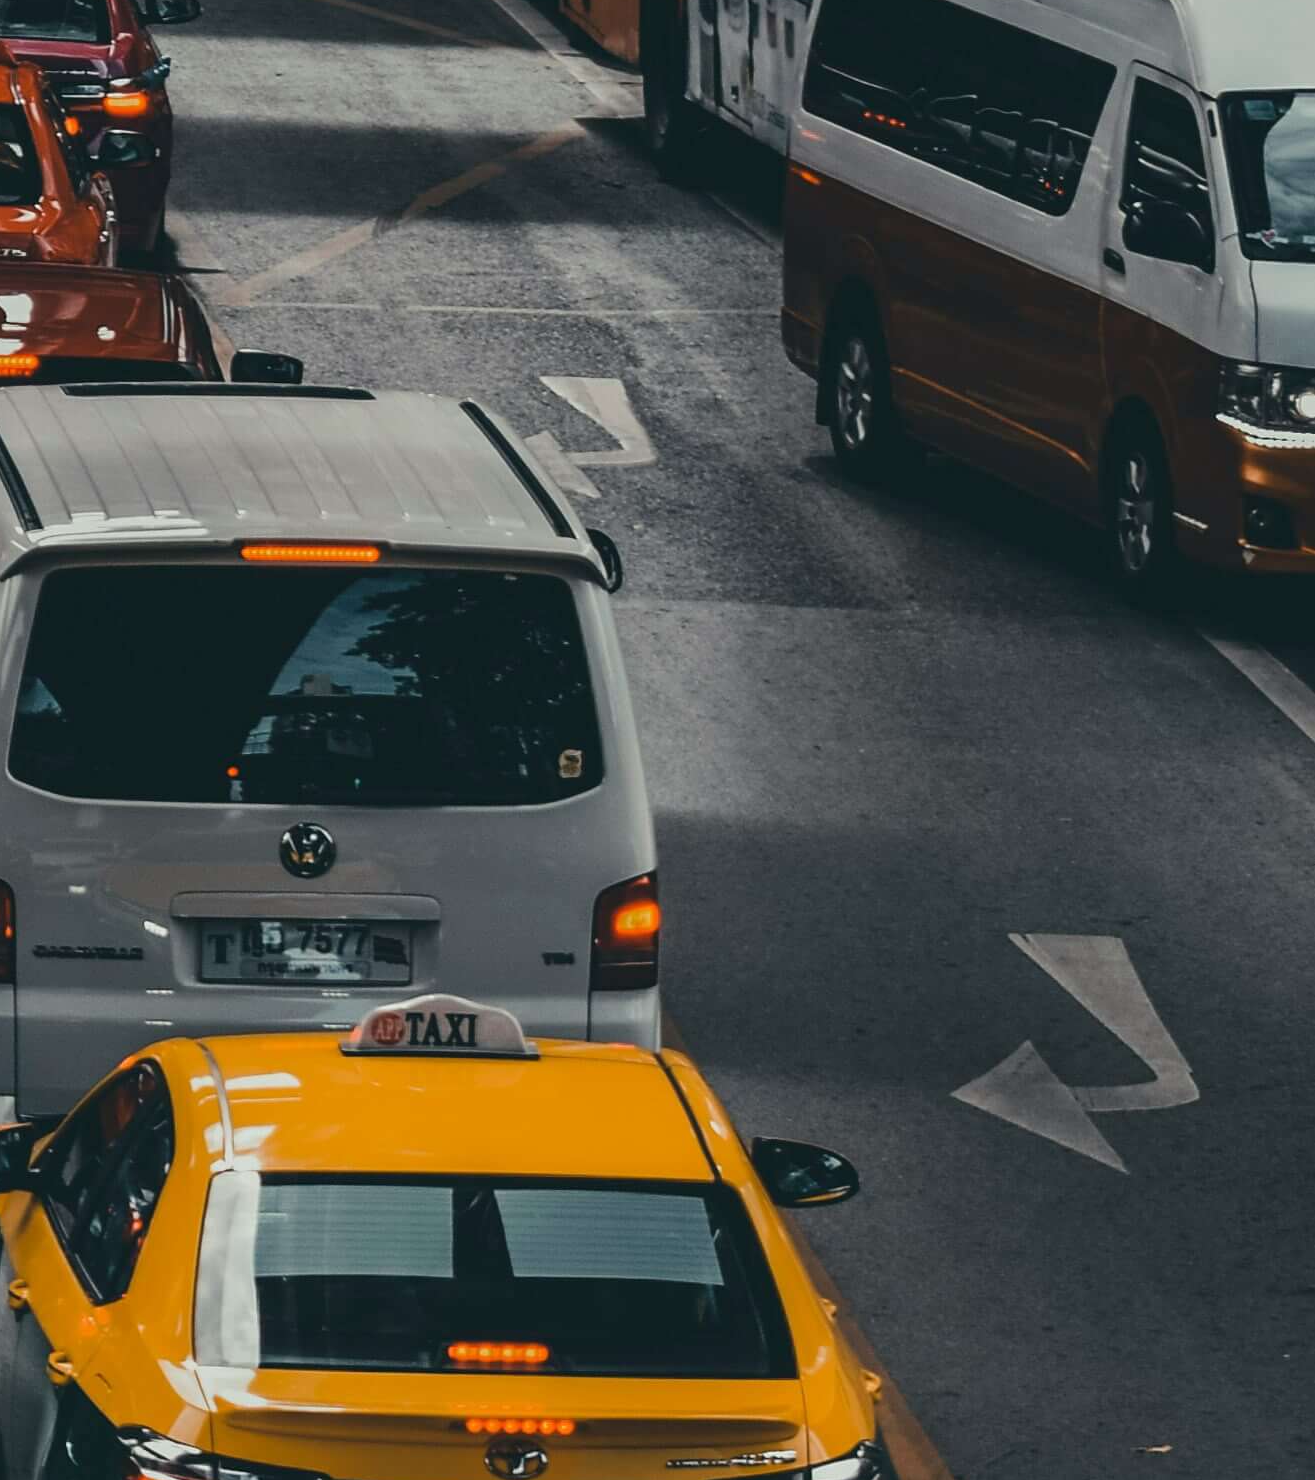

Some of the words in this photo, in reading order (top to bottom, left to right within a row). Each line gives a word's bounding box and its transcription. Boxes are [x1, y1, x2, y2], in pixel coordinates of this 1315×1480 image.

[208, 933, 235, 964] T
[300, 923, 366, 956] 7577
[406, 1012, 477, 1047] TAXI
